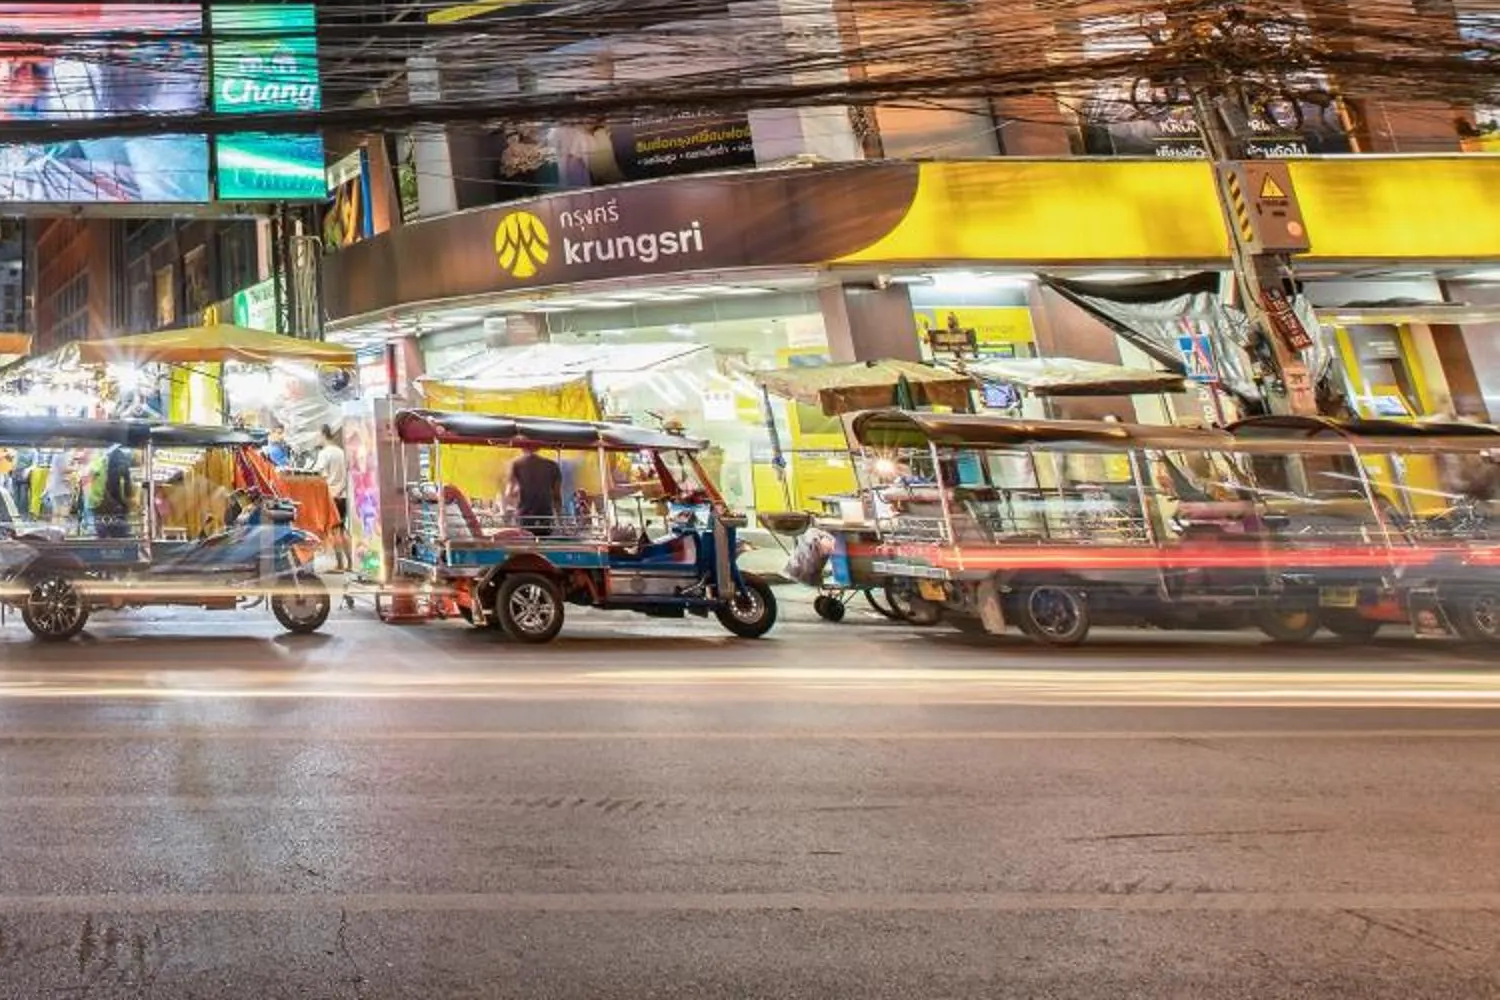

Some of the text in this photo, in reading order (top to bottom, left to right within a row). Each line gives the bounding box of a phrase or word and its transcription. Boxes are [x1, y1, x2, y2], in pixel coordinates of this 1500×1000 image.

[221, 77, 317, 110] Chang
[559, 197, 620, 233] กรุงศรี
[563, 221, 704, 265] krungsri
